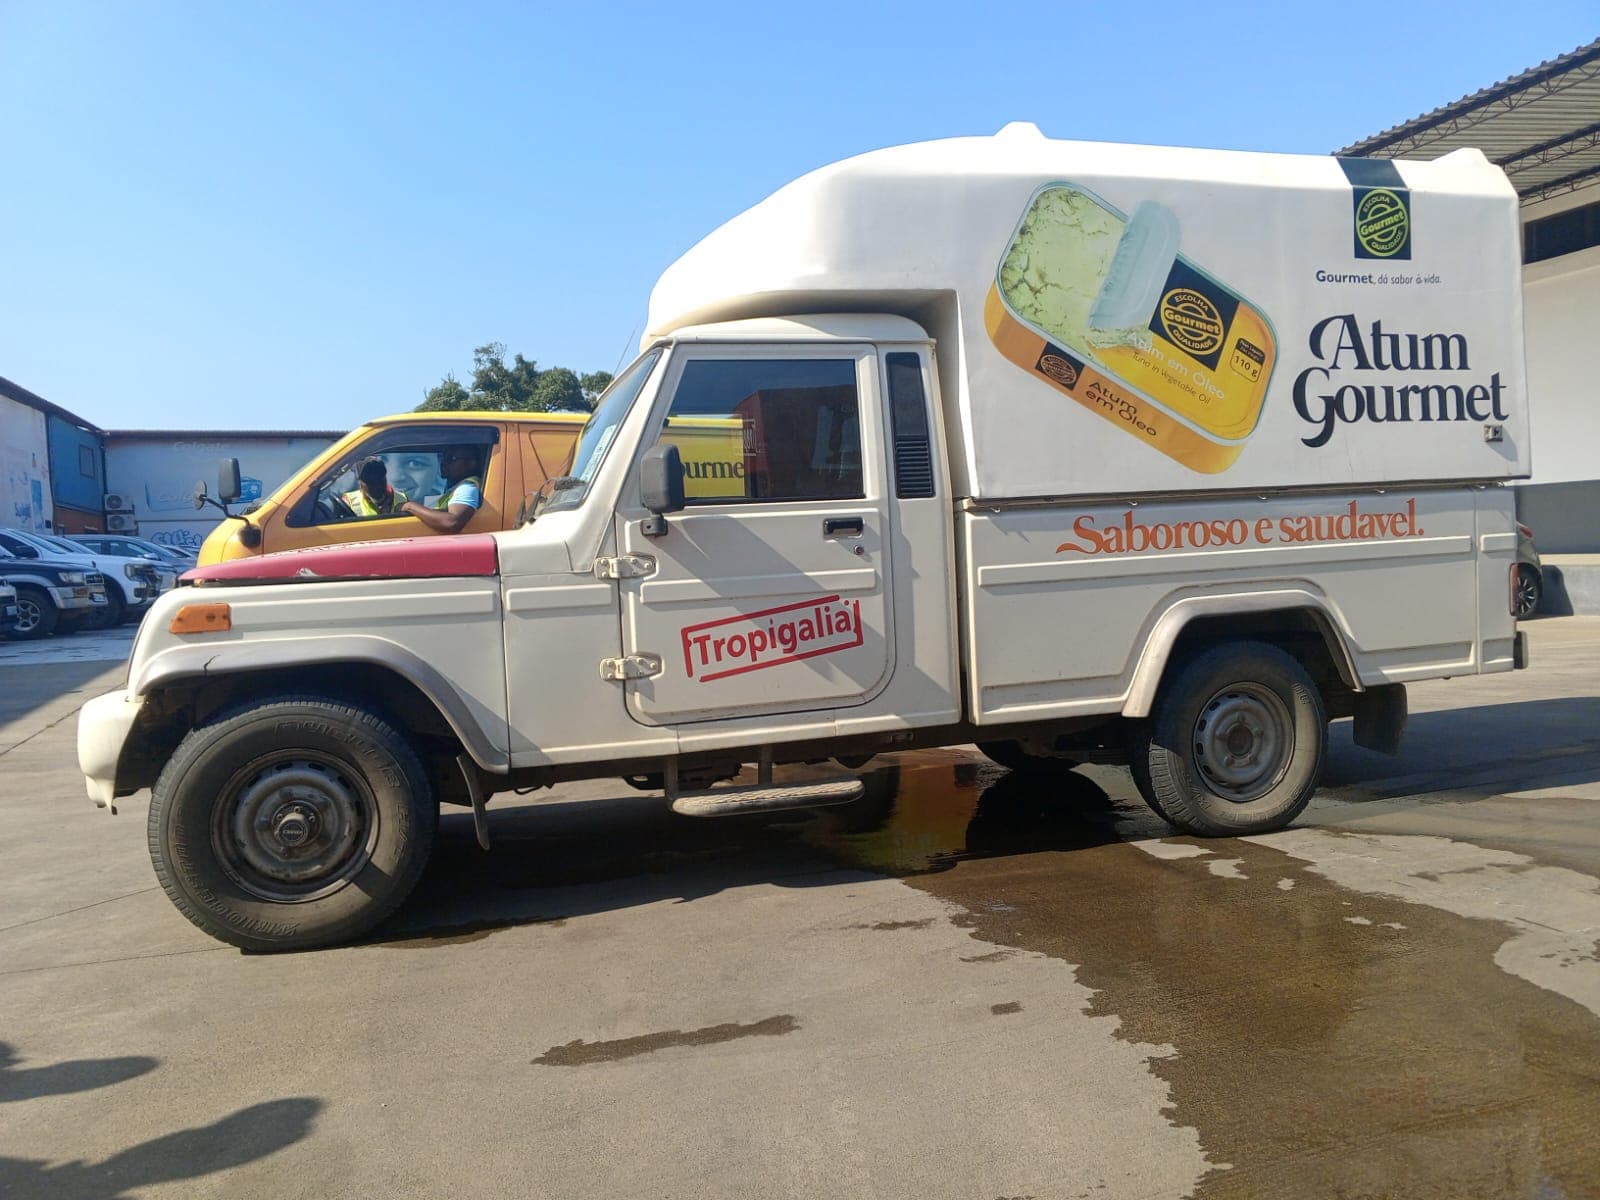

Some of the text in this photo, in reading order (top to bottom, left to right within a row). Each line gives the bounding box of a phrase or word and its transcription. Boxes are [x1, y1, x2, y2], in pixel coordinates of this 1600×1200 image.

[1361, 211, 1405, 236] Gourmet
[1390, 274, 1414, 285] sabor
[1174, 294, 1209, 312] ESCOLHA
[1164, 310, 1221, 335] Gourmet
[1172, 328, 1214, 350] QUALIDADE
[1309, 314, 1471, 371] Atum
[1132, 351, 1211, 405] Tuna in Vegetable Oil
[1168, 358, 1188, 376] em
[1234, 355, 1258, 378] 110 g
[1085, 390, 1114, 411] em
[1088, 381, 1138, 415] Atum
[1292, 367, 1510, 448] Gourmet
[1055, 498, 1425, 555] Saboroso e saudavel.
[692, 604, 852, 665] Tropigalia
